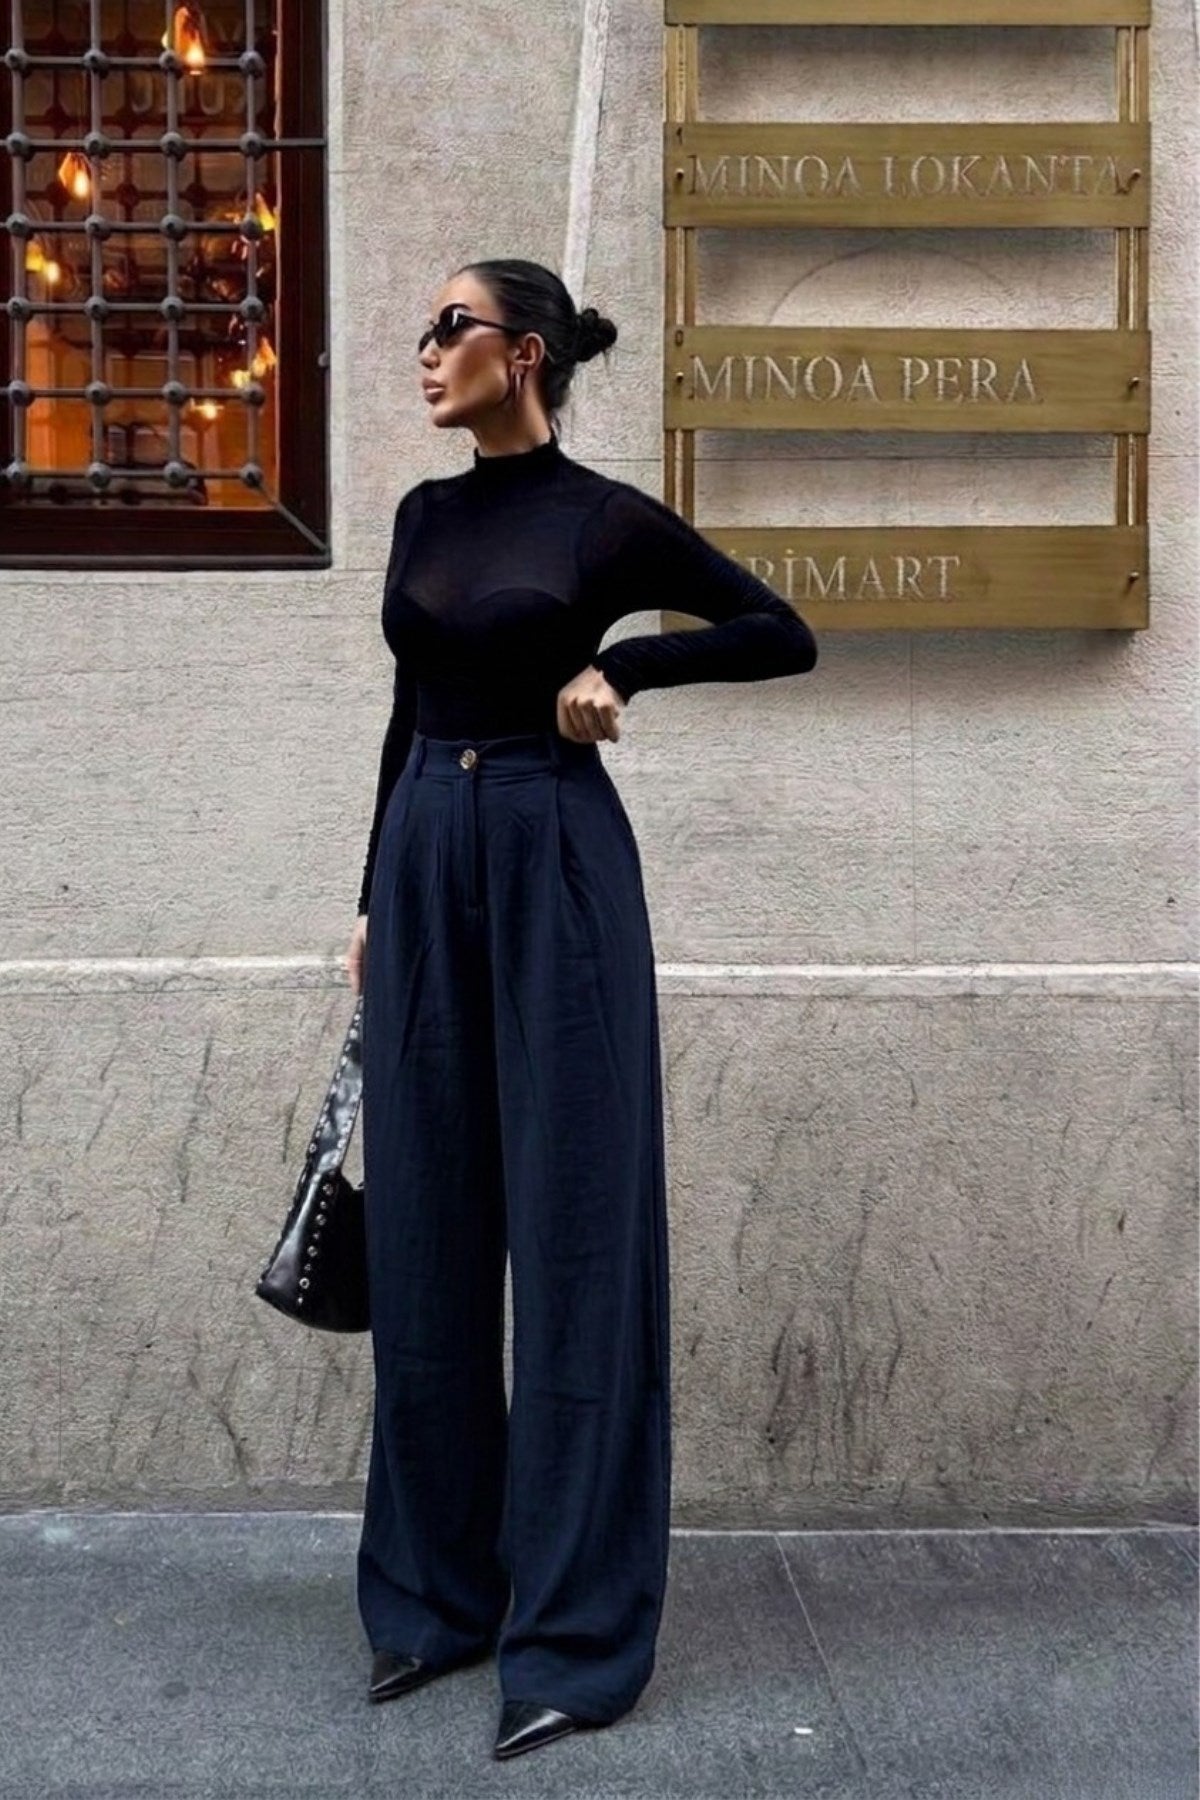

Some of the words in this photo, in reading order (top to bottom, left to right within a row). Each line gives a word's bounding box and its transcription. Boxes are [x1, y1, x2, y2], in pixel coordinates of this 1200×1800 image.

[688, 154, 862, 198] MINOA
[880, 154, 1129, 198] LOKANTA
[691, 354, 881, 402] MINOA
[900, 354, 1043, 403] PERA
